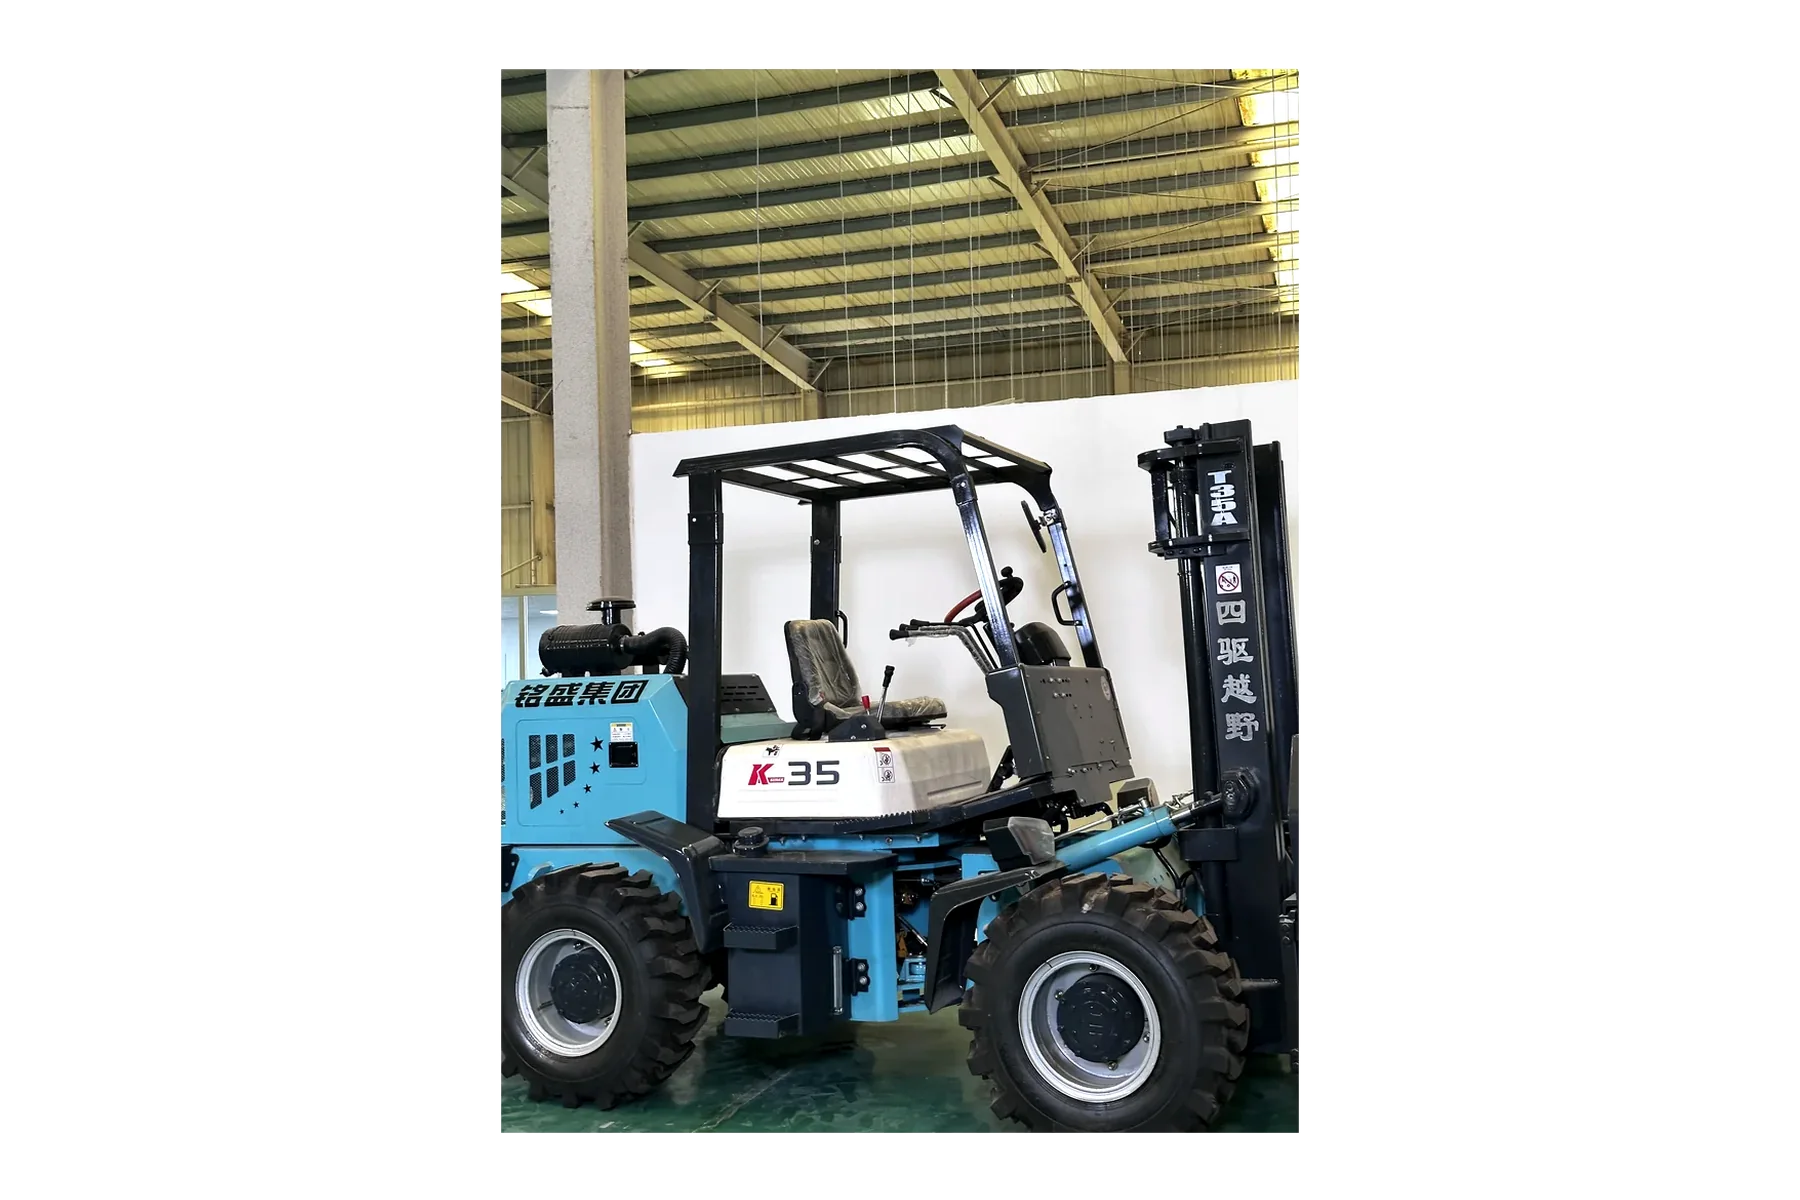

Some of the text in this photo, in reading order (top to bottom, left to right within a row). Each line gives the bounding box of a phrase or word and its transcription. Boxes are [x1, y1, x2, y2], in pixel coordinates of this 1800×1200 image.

[1207, 469, 1239, 526] T35A
[514, 679, 649, 708] 铭盛集团
[1216, 599, 1260, 742] 四驱越野
